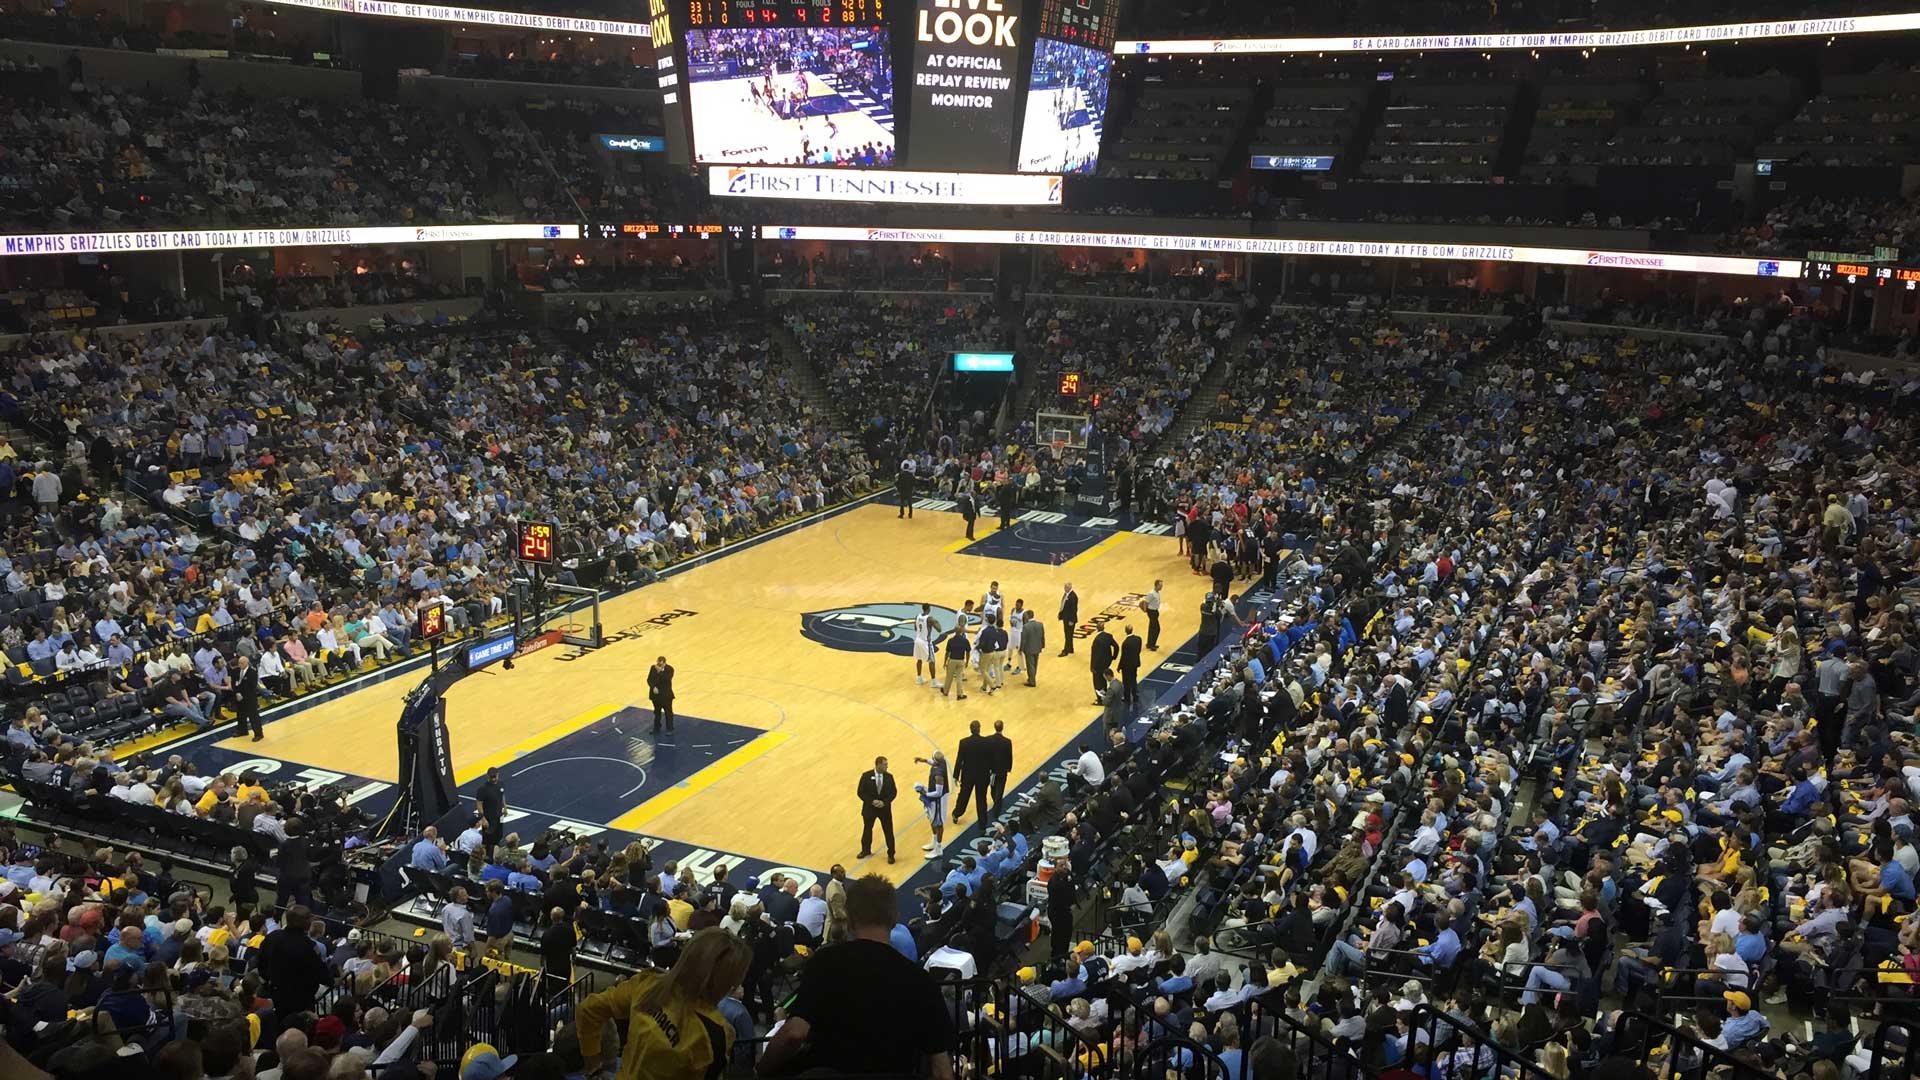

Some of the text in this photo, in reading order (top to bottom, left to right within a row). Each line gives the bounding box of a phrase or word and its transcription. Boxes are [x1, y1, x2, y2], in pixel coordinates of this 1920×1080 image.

[690, 1, 702, 13] 33
[798, 7, 831, 22] 4 2
[405, 5, 422, 17] GET
[426, 7, 450, 19] YOUR
[454, 9, 495, 23] MEMPHIS
[499, 13, 542, 27] GRIZZLIES
[546, 17, 570, 30] DEBIT
[574, 19, 595, 32] CARD
[599, 21, 624, 34] TODAY
[628, 23, 638, 34] AT
[690, 14, 703, 25] 50
[746, 9, 770, 23] 4 4
[842, 11, 855, 22] 88
[650, 14, 673, 49] LOOK
[917, 10, 1018, 47] LOOK
[1353, 39, 1363, 49] BE
[1367, 39, 1373, 49] A
[1499, 36, 1516, 47] GET
[1521, 35, 1545, 46] YOUR
[1550, 34, 1594, 45] MEMPHIS
[1599, 32, 1645, 45] GRIZZLIES
[1648, 30, 1674, 42] DEBIT
[1677, 29, 1701, 41] CARD
[1705, 27, 1733, 40] TODAY
[1738, 25, 1749, 37] AT
[926, 54, 1002, 71] AT OFFICIAL
[917, 74, 1011, 90] REPLAY REVIEW
[931, 93, 993, 109] MONITOR
[750, 173, 965, 196] FIRST TENNESSEE
[623, 225, 659, 233] GRIZZLIES
[6, 236, 65, 253] MEMPHIS
[70, 234, 131, 251] GRIZZLIES
[136, 233, 168, 249] DEBIT
[173, 232, 201, 247] CARD
[205, 231, 237, 246] TODAY
[243, 231, 254, 245] AT
[879, 231, 899, 240] FIRST
[1015, 233, 1025, 242] BE
[1030, 233, 1035, 243] A
[1153, 237, 1169, 248] GET
[1173, 238, 1196, 249] YOUR
[1200, 239, 1242, 251] MEMPHIS
[1246, 240, 1294, 252] GRIZZLIES
[1298, 242, 1325, 253] DEBIT
[1329, 242, 1354, 254] CARD
[1359, 243, 1389, 256] TODAY
[1394, 245, 1405, 256] AT
[1599, 255, 1618, 265] FIRST
[1619, 256, 1664, 267] TENNESSEE
[1837, 264, 1869, 276] GRIZZLIES
[1062, 381, 1076, 394] 24
[531, 525, 550, 538] 1:59
[525, 537, 547, 559] 24
[426, 619, 439, 634] 24
[474, 649, 491, 660] GAME
[502, 641, 514, 652] APP
[434, 729, 447, 776] NBA TV
